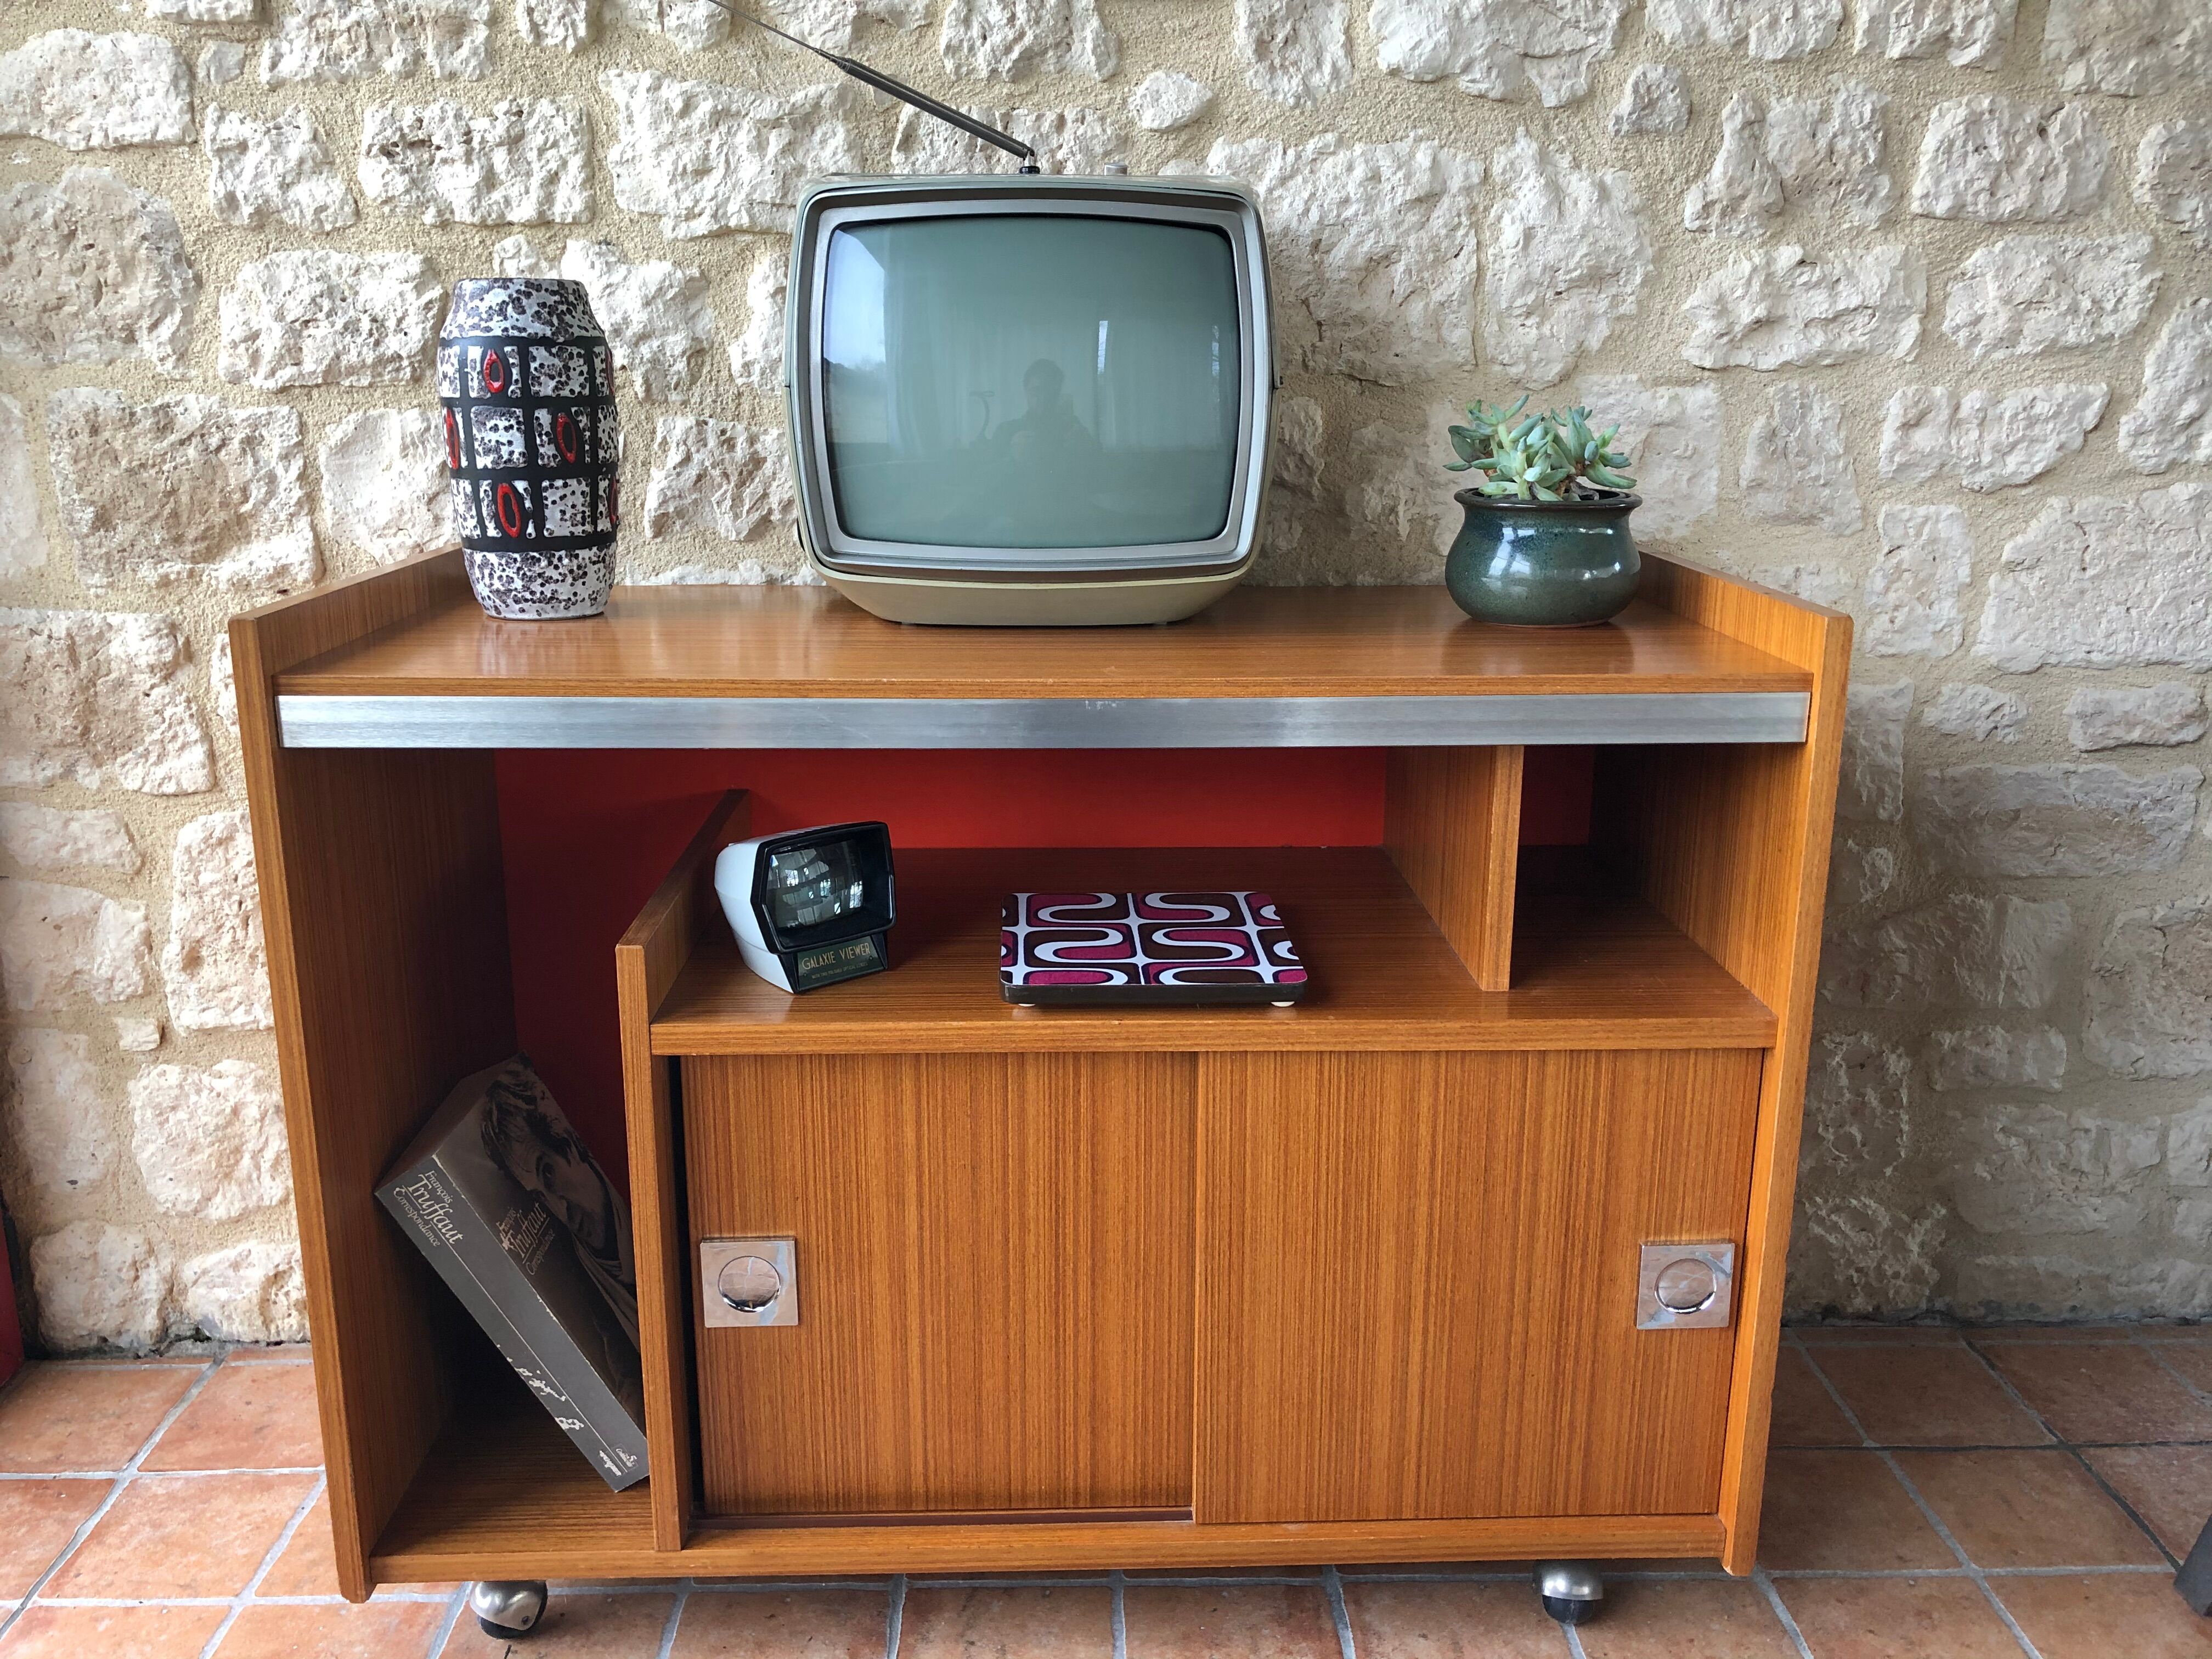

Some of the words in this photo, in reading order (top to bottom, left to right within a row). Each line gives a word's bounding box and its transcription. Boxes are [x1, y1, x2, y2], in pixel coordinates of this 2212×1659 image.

[802, 951, 836, 969] GALAXIE
[839, 943, 871, 960] VIEWER
[407, 1174, 464, 1244] Truffaut
[425, 1170, 453, 1204] François
[393, 1187, 441, 1246] Correspondance
[506, 1201, 546, 1258] Truffaut
